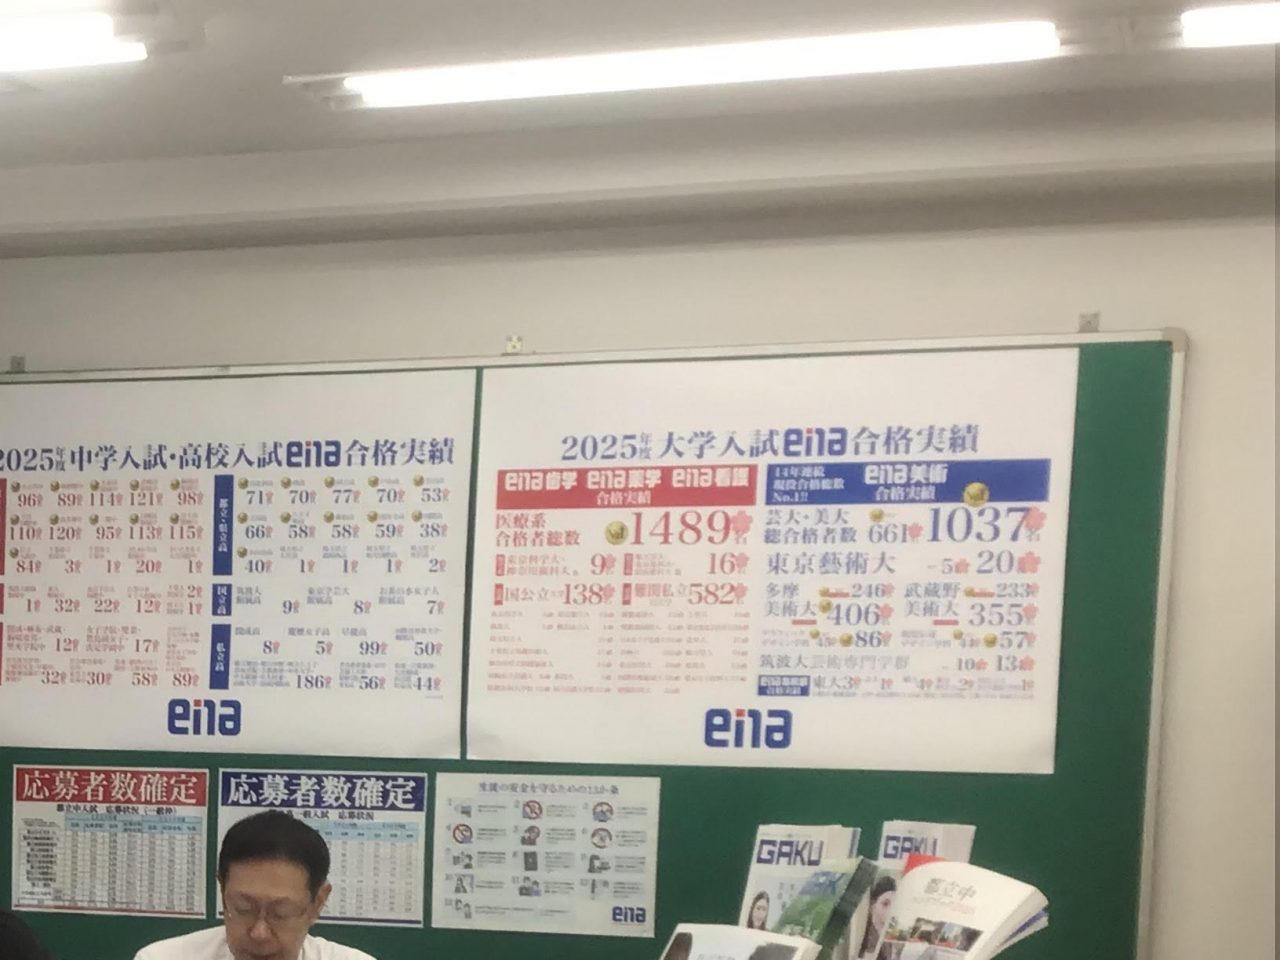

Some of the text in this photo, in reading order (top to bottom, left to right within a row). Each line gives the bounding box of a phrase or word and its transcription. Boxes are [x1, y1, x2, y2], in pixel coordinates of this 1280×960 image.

[631, 510, 732, 545] 1489
[926, 506, 1031, 543] 1037
[590, 553, 607, 576] 9
[708, 552, 737, 575] 16
[976, 550, 1015, 575] 20
[563, 583, 604, 605] 138
[687, 582, 736, 605] 582
[826, 602, 882, 627] 406
[969, 602, 1023, 627] 355
[55, 637, 73, 652] 12
[134, 638, 152, 653] 17
[359, 641, 381, 656] 99
[414, 641, 435, 656] 50
[854, 631, 882, 648] 86
[41, 671, 59, 685] 32
[86, 671, 105, 685] 30
[131, 671, 151, 686] 58
[172, 672, 192, 687] 89
[296, 674, 325, 690] 186
[167, 698, 242, 736] ena
[703, 708, 793, 750] ena
[22, 770, 199, 804] 応募者数確定
[227, 773, 417, 810] 応募者数確定
